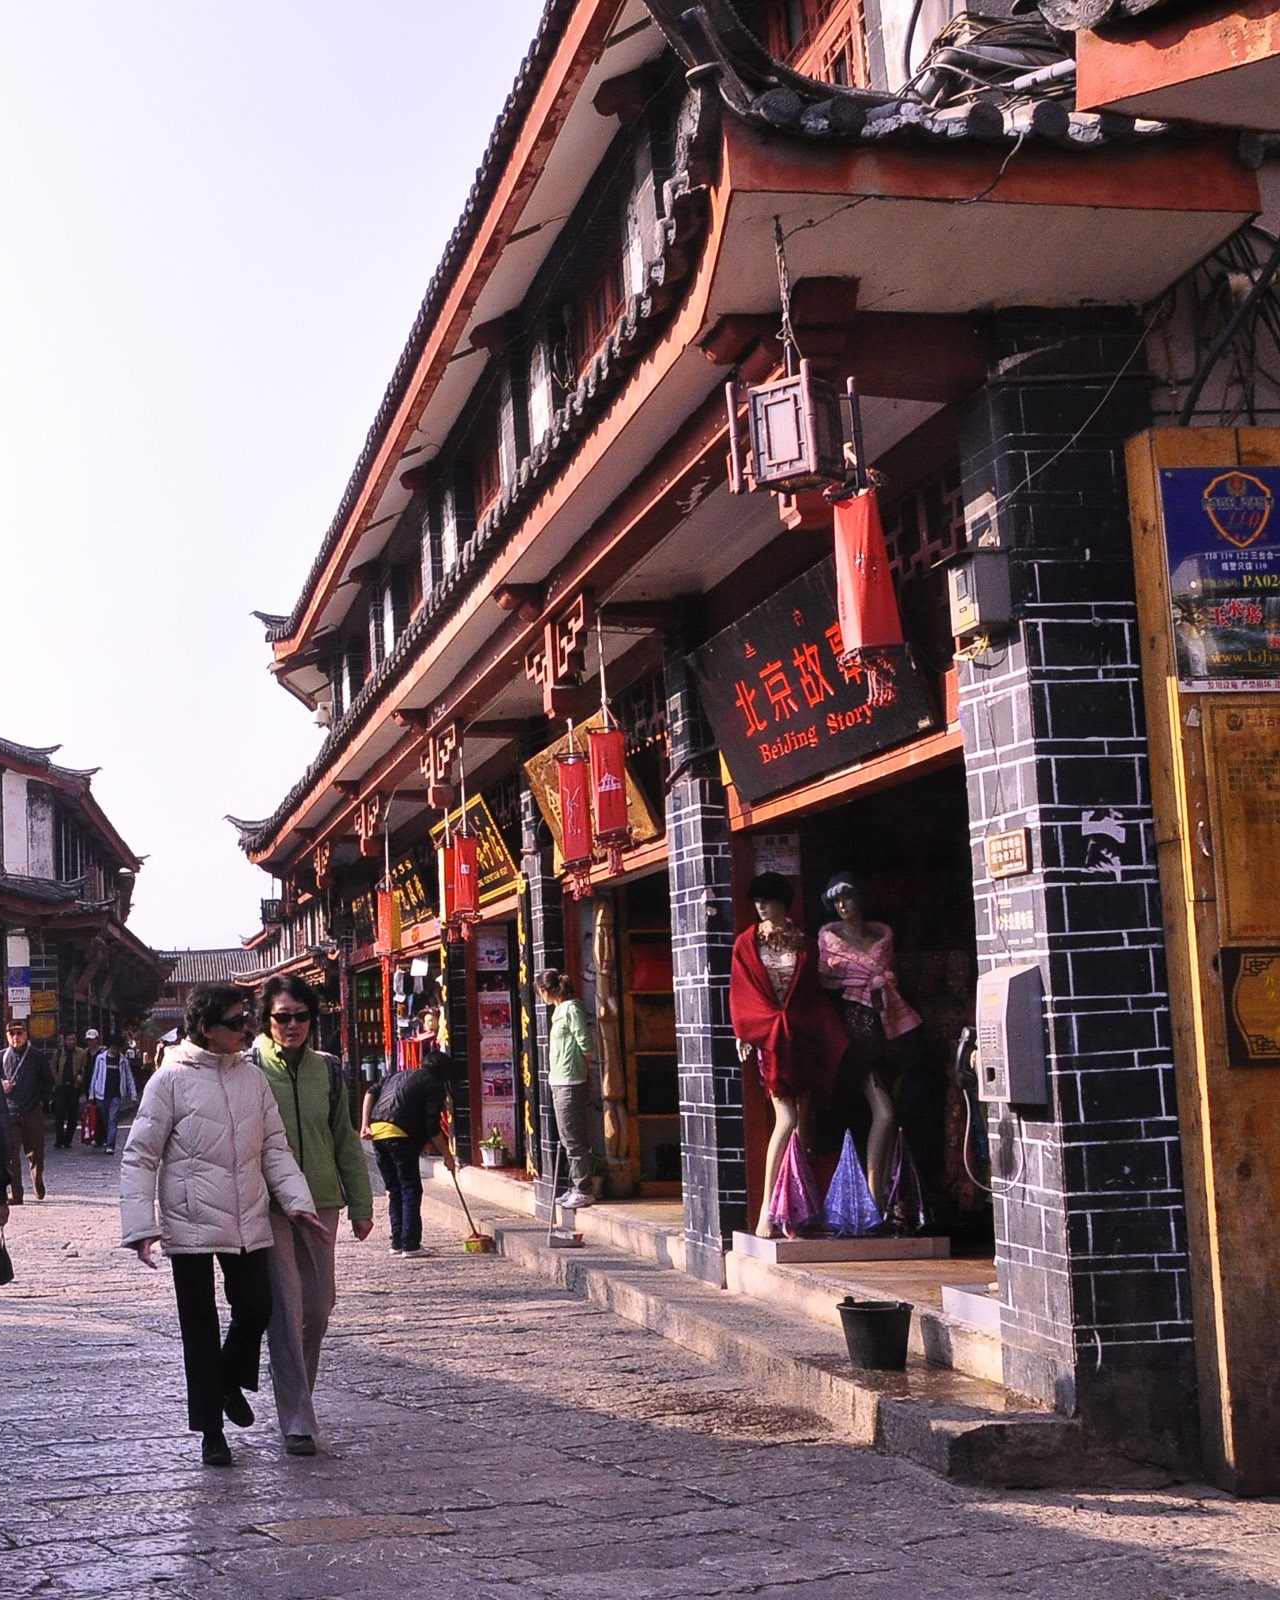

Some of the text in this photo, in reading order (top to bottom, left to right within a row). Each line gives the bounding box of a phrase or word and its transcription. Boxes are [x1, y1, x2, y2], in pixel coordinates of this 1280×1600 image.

[1242, 574, 1280, 588] PA02
[759, 703, 874, 765] BeiJing Story
